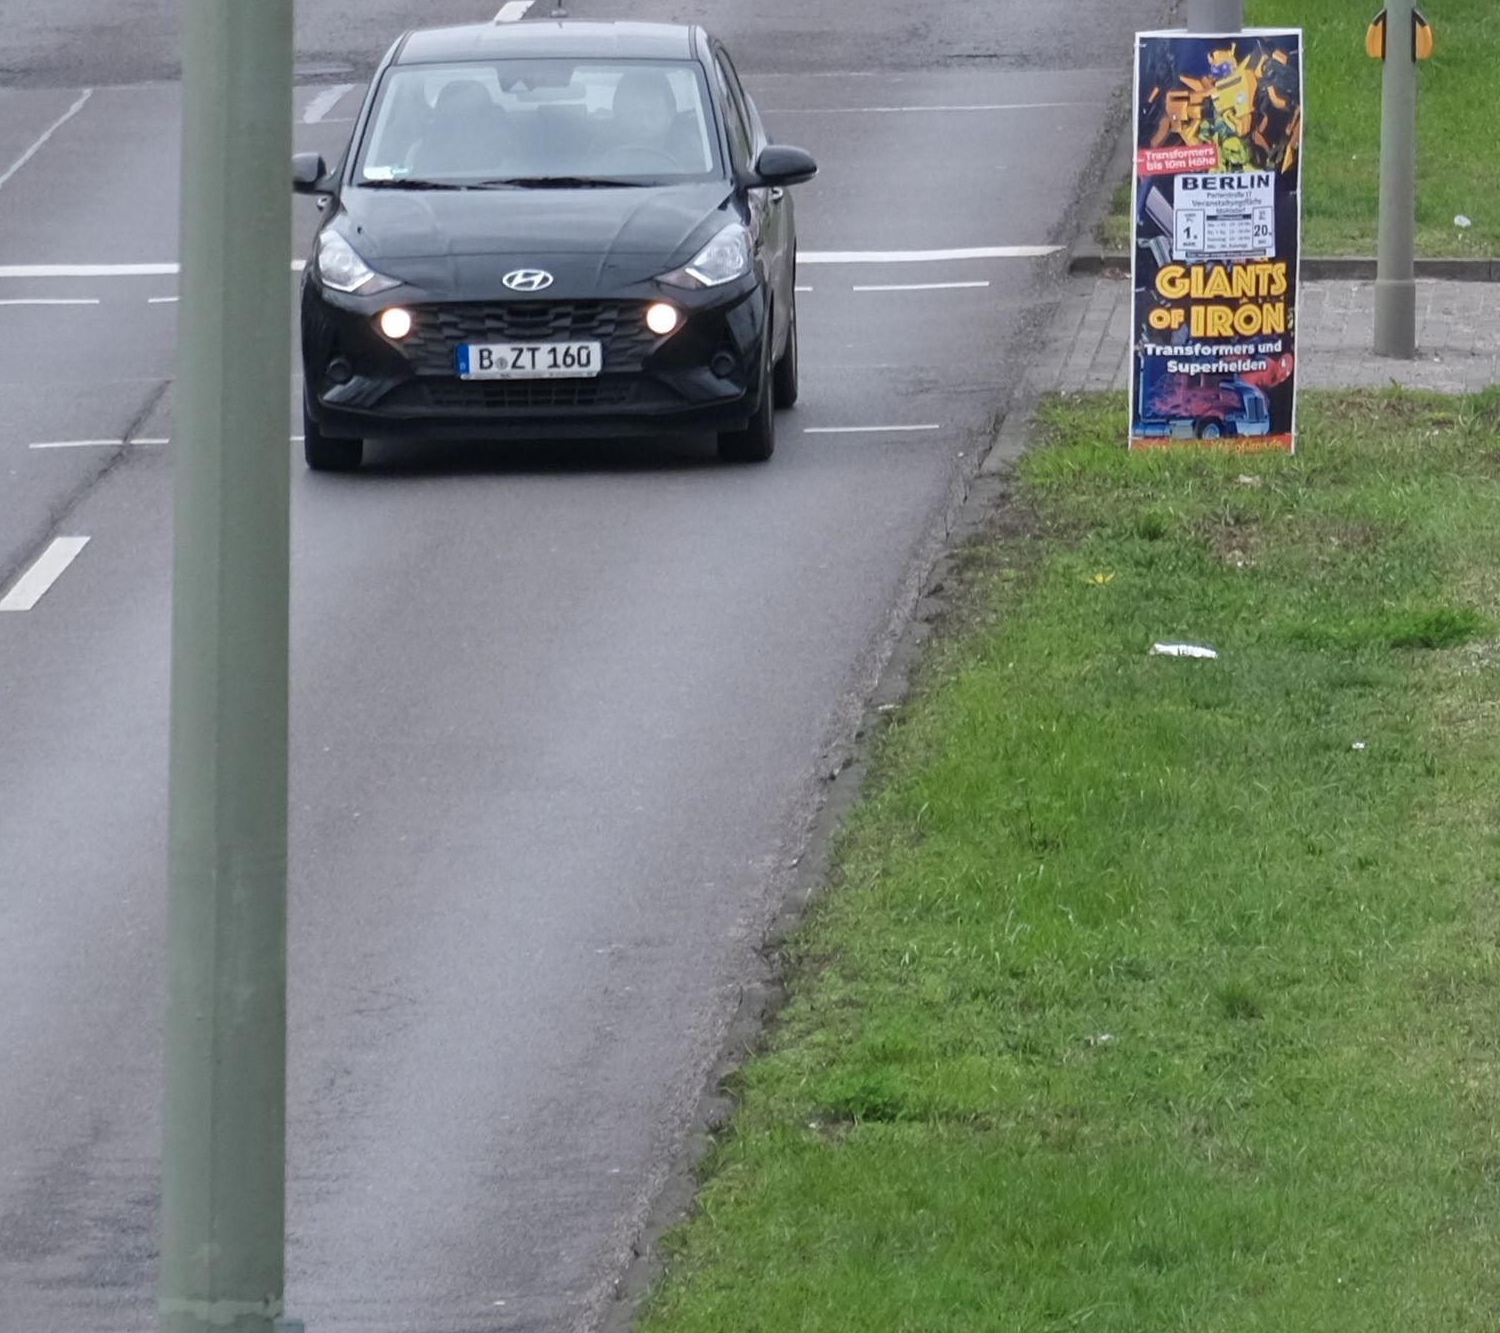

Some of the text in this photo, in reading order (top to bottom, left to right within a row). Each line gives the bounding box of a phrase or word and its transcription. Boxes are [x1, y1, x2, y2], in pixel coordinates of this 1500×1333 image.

[1181, 174, 1270, 191] BERLIN
[1154, 261, 1288, 300] GIANTS
[1148, 301, 1285, 338] OF IRON
[478, 346, 592, 371] B ZT 160
[1144, 339, 1283, 357] Transformers und
[1166, 359, 1267, 377] Superhelden
